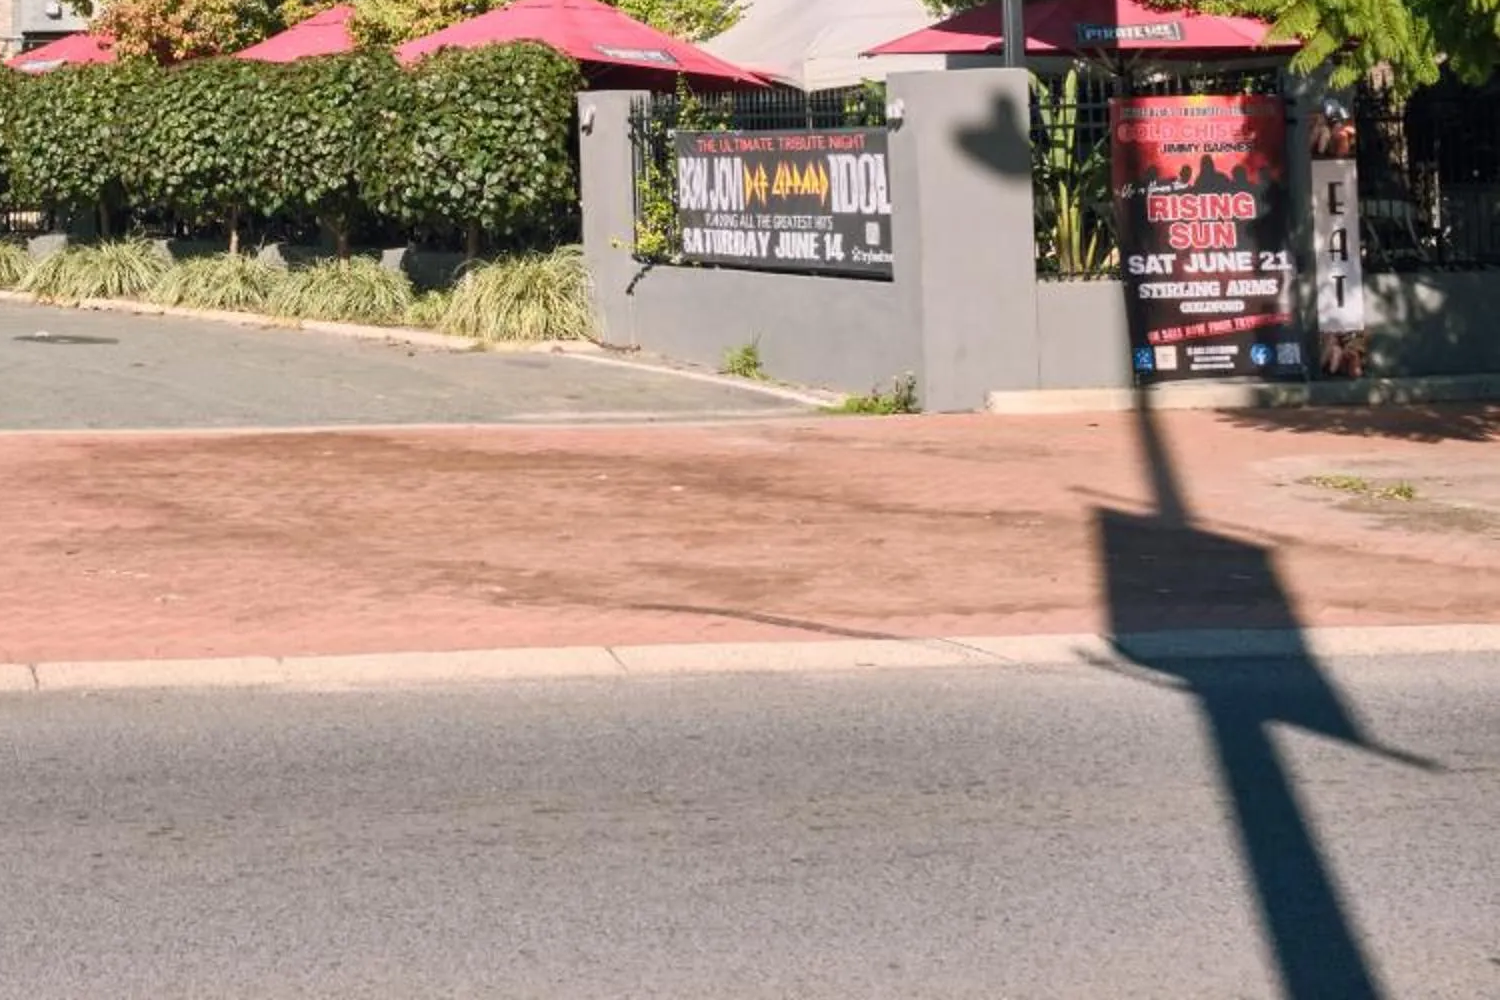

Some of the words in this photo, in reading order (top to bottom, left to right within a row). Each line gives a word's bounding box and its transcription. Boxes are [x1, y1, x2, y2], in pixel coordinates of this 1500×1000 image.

[697, 139, 717, 153] THE
[720, 137, 774, 152] ULTIMATE
[780, 135, 826, 151] TRIBUTE
[828, 133, 865, 149] NIGHT
[679, 157, 708, 211] BON
[709, 157, 744, 211] JOVI
[744, 161, 768, 207] DEF
[827, 153, 892, 214] IDOL
[740, 213, 755, 228] ALL
[757, 214, 772, 229] THE
[1147, 191, 1257, 221] RISING
[683, 227, 770, 257] SATURDAY
[774, 231, 820, 259] JUNE
[824, 233, 845, 261] 14
[1169, 221, 1237, 249] SUN
[1327, 181, 1348, 308] EAT
[1128, 253, 1177, 274] SAT
[1183, 251, 1253, 273] JUNE
[1259, 251, 1292, 271] 21
[1139, 281, 1221, 299] STIRLING
[1226, 279, 1278, 297] ARMS
